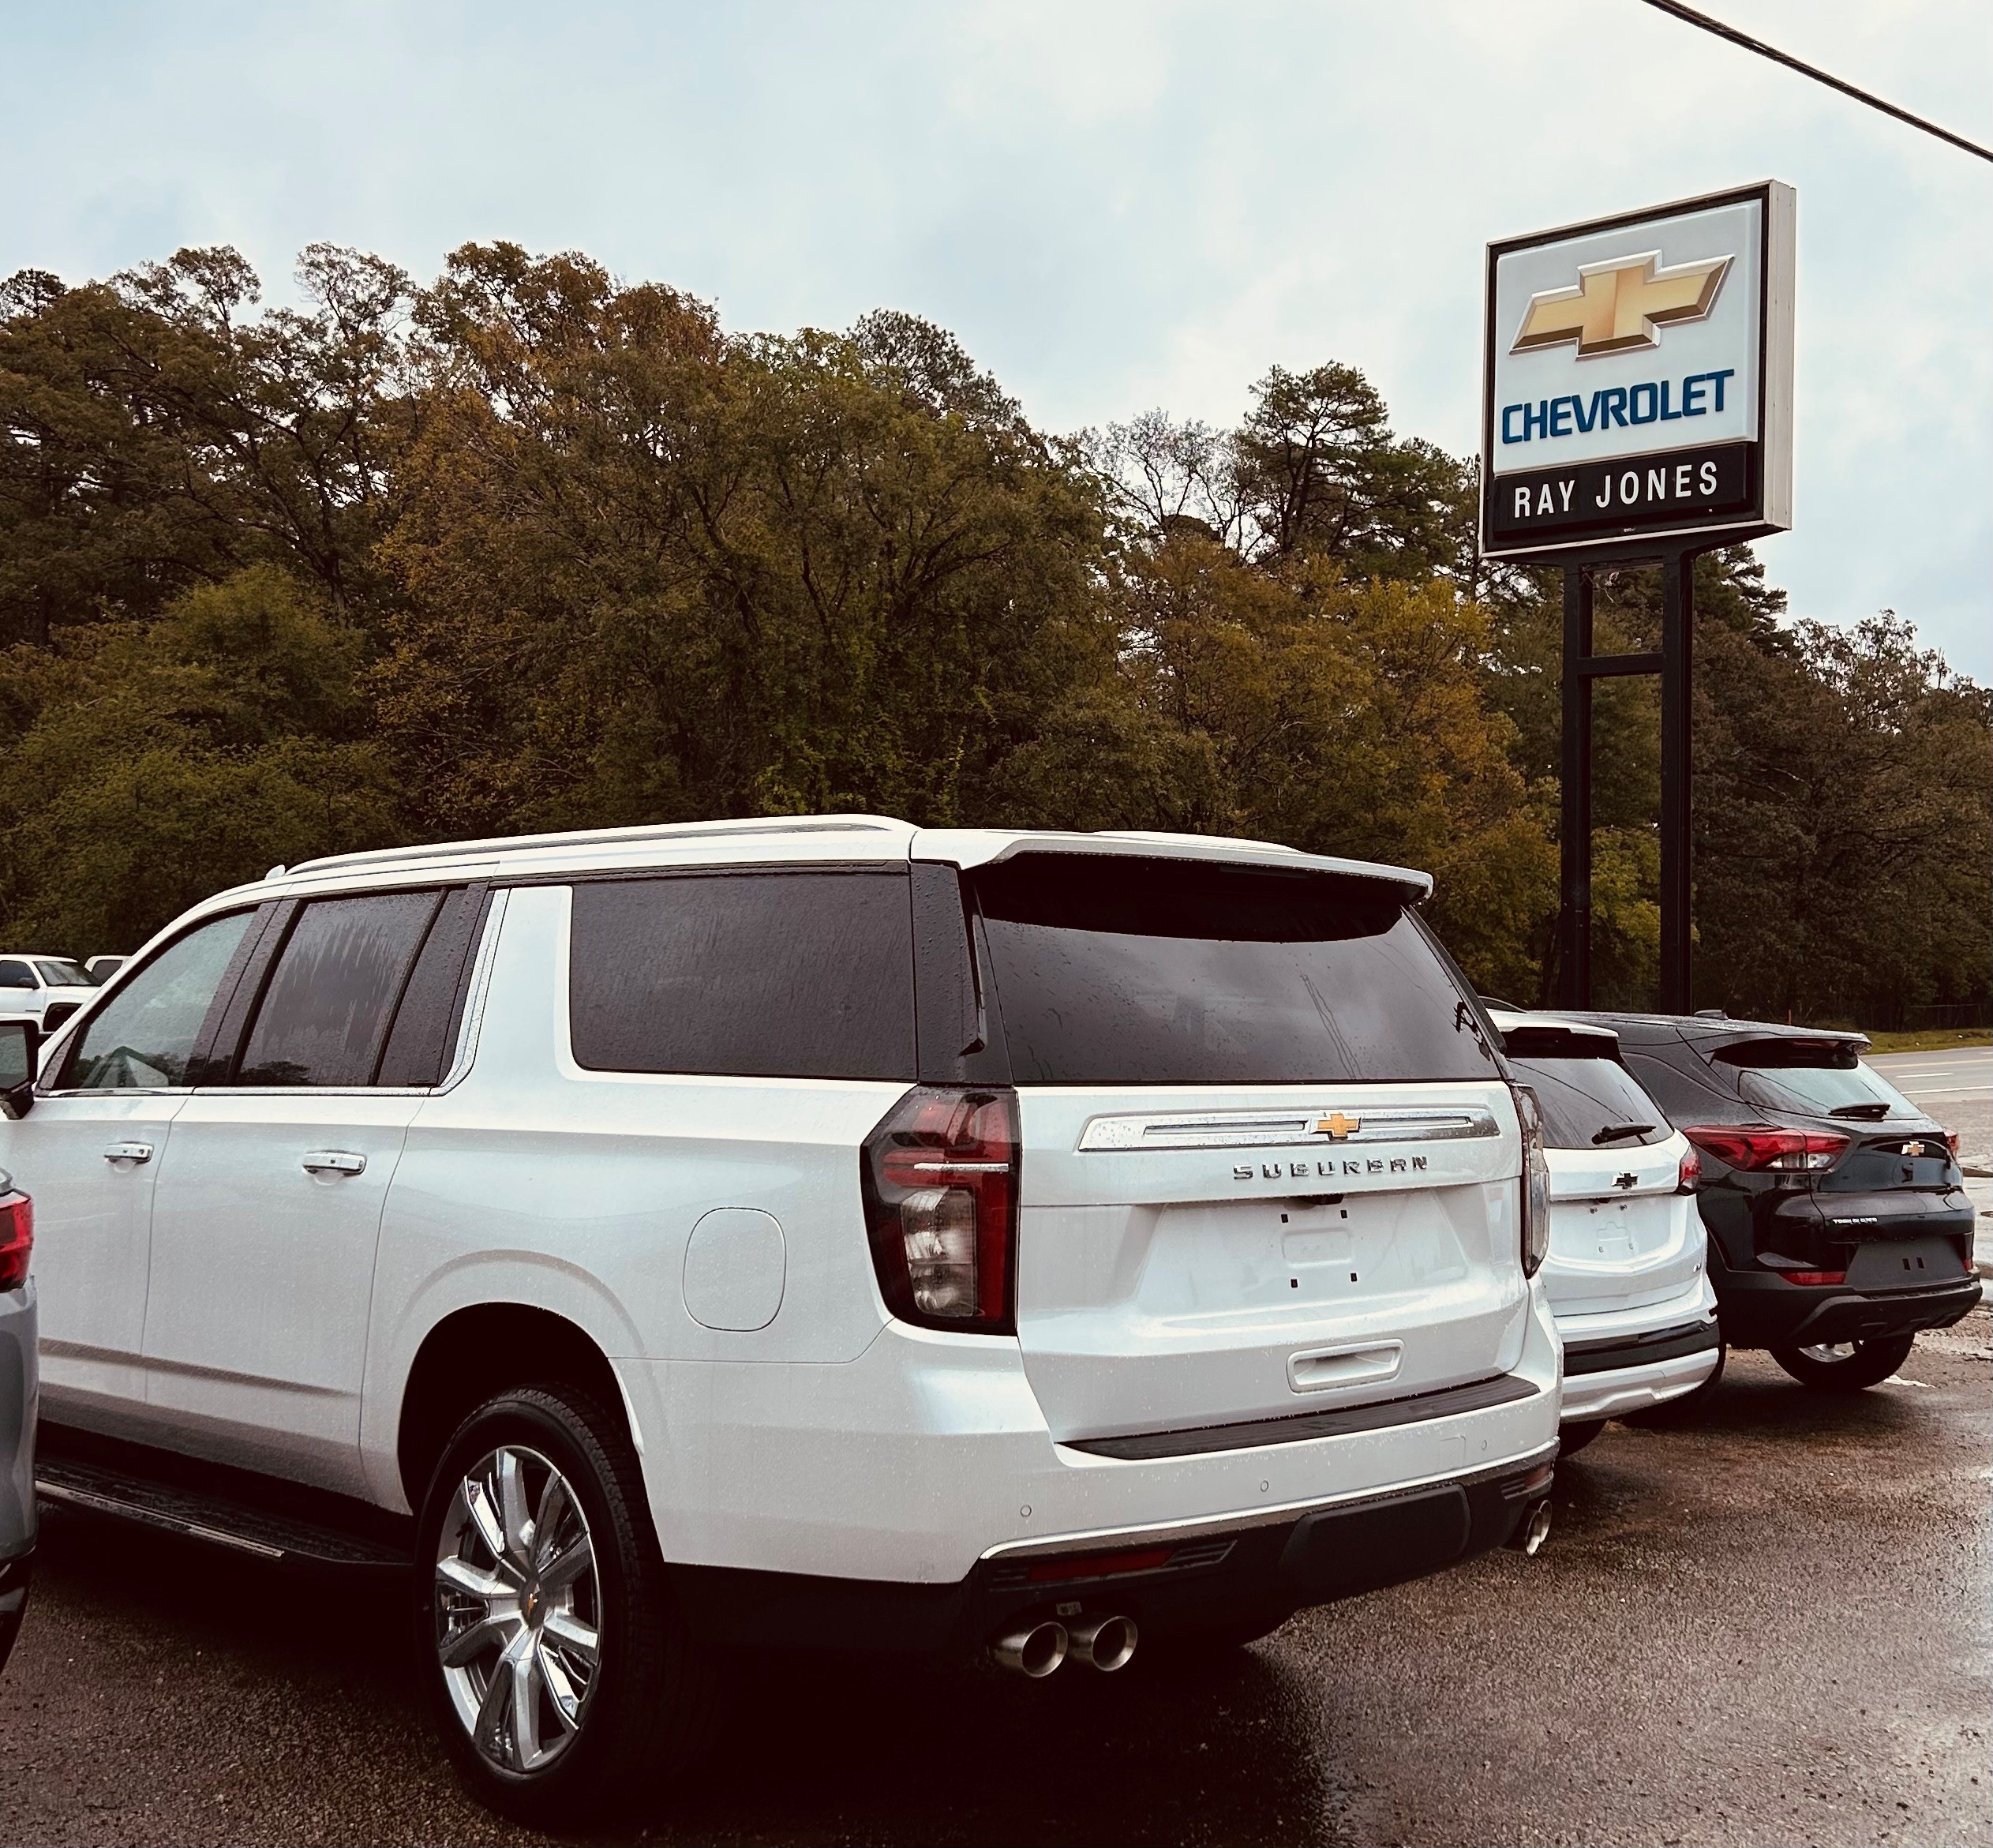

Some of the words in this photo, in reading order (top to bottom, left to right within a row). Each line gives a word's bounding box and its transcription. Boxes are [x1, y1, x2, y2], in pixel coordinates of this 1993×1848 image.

[1502, 369, 1735, 444] CHEVROLET
[1514, 479, 1575, 518] RAY
[1595, 461, 1718, 508] JONES
[1233, 1156, 1428, 1179] SUBURBAN
